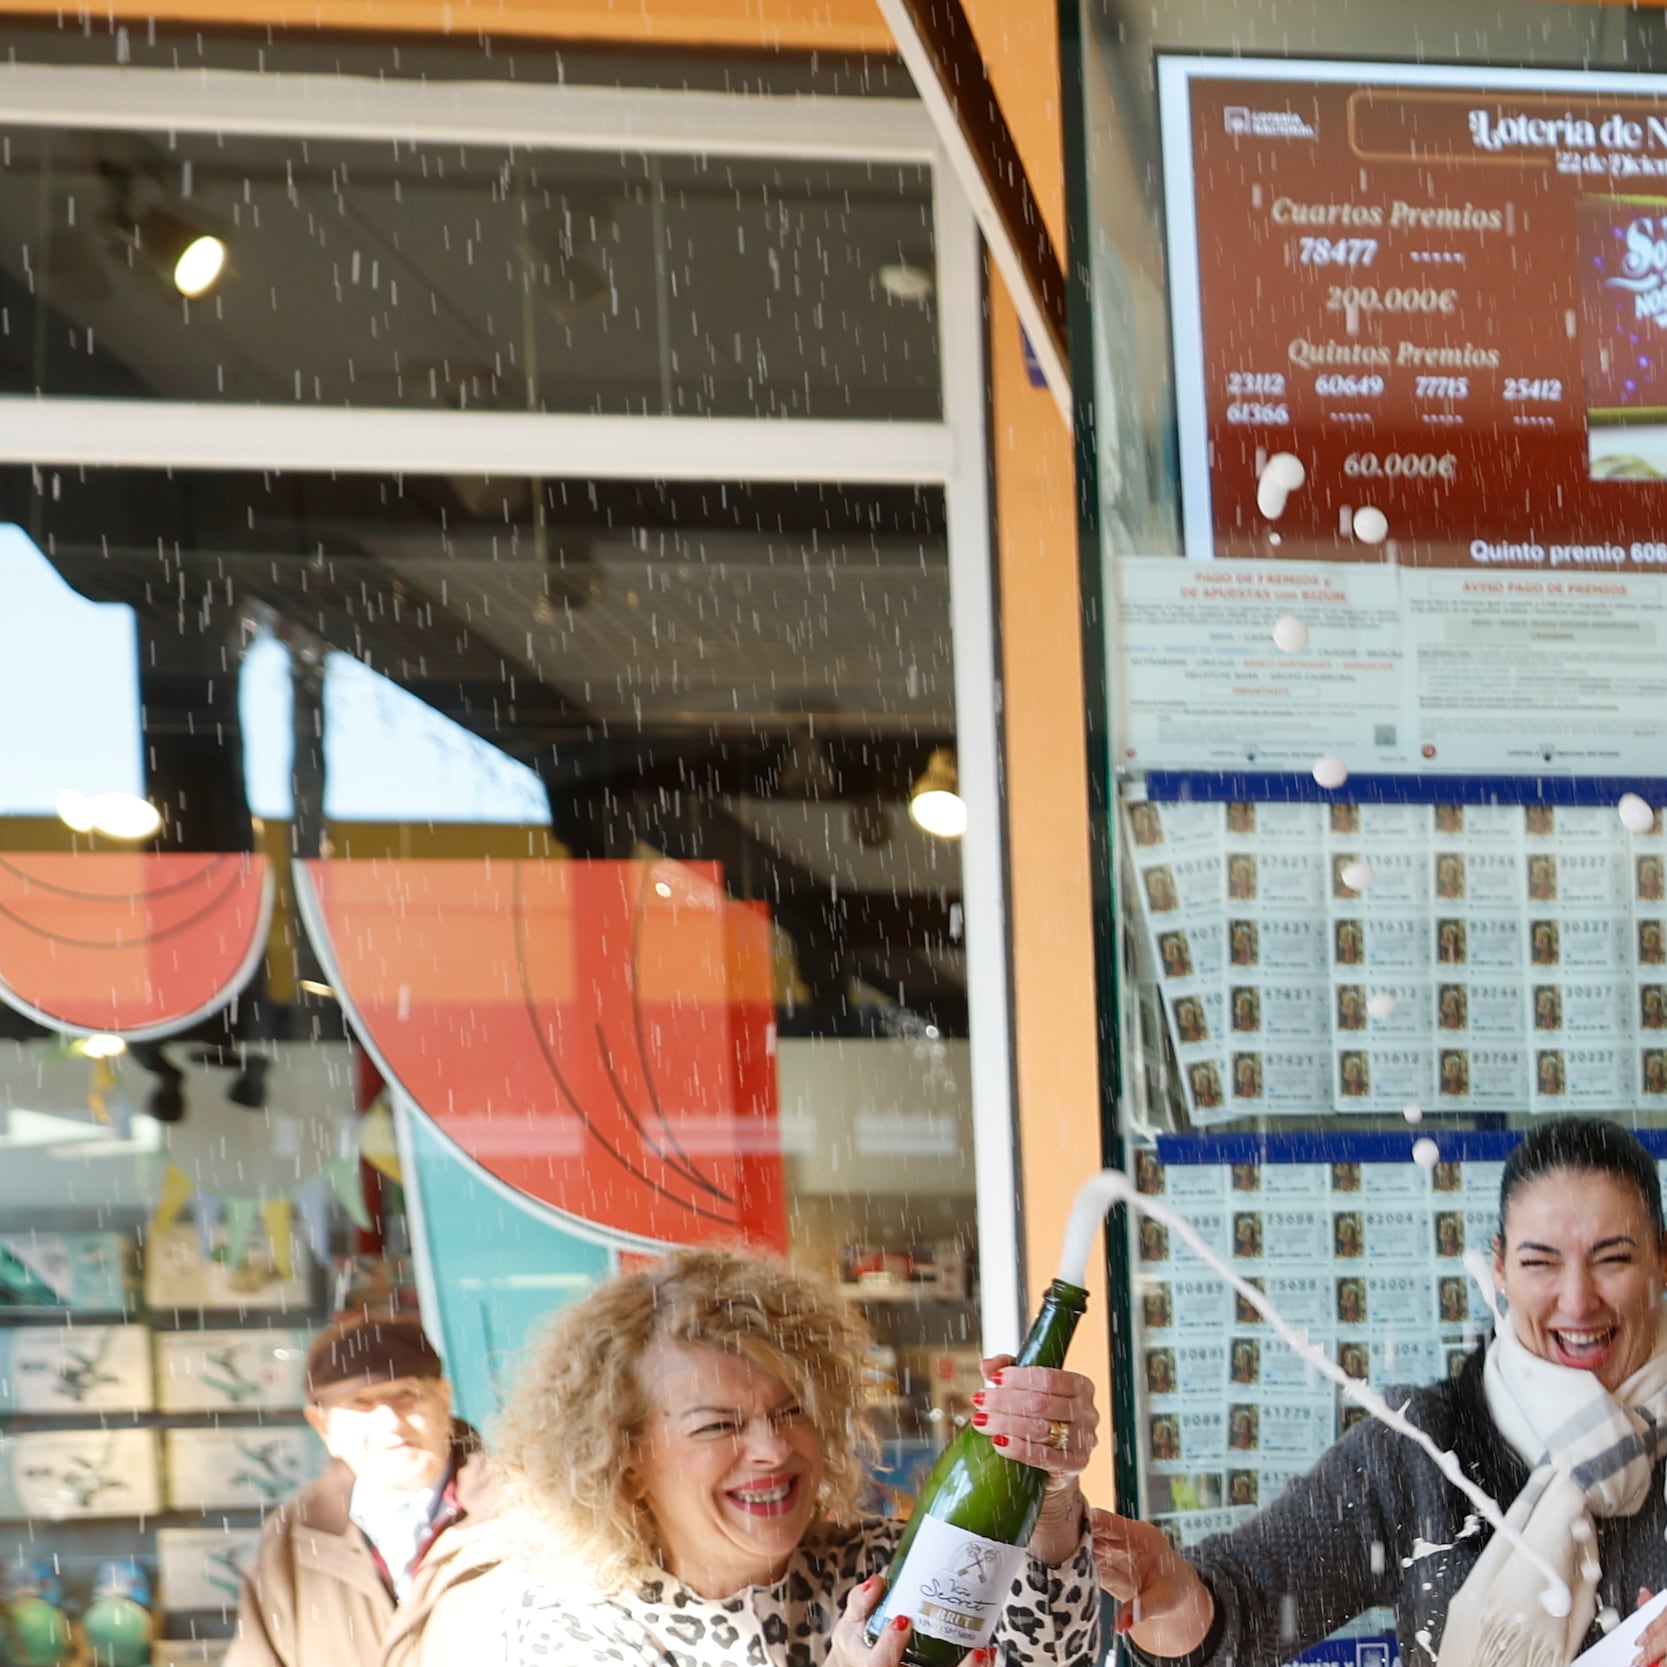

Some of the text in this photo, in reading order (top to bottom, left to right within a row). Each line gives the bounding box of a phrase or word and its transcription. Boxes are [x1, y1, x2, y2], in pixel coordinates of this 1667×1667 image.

[1600, 114, 1642, 149] de
[1271, 197, 1503, 231] Cuartos Premios
[1299, 237, 1379, 266] 78477
[1326, 286, 1458, 313] 200.000€
[1287, 338, 1500, 369] Quintos Premios
[1226, 372, 1286, 396] 23112
[1314, 375, 1384, 397] 60649
[1343, 454, 1457, 480] 60.000€
[1470, 540, 1544, 563] Quinto
[1550, 545, 1626, 567] premio
[936, 1608, 974, 1628] BRUT
